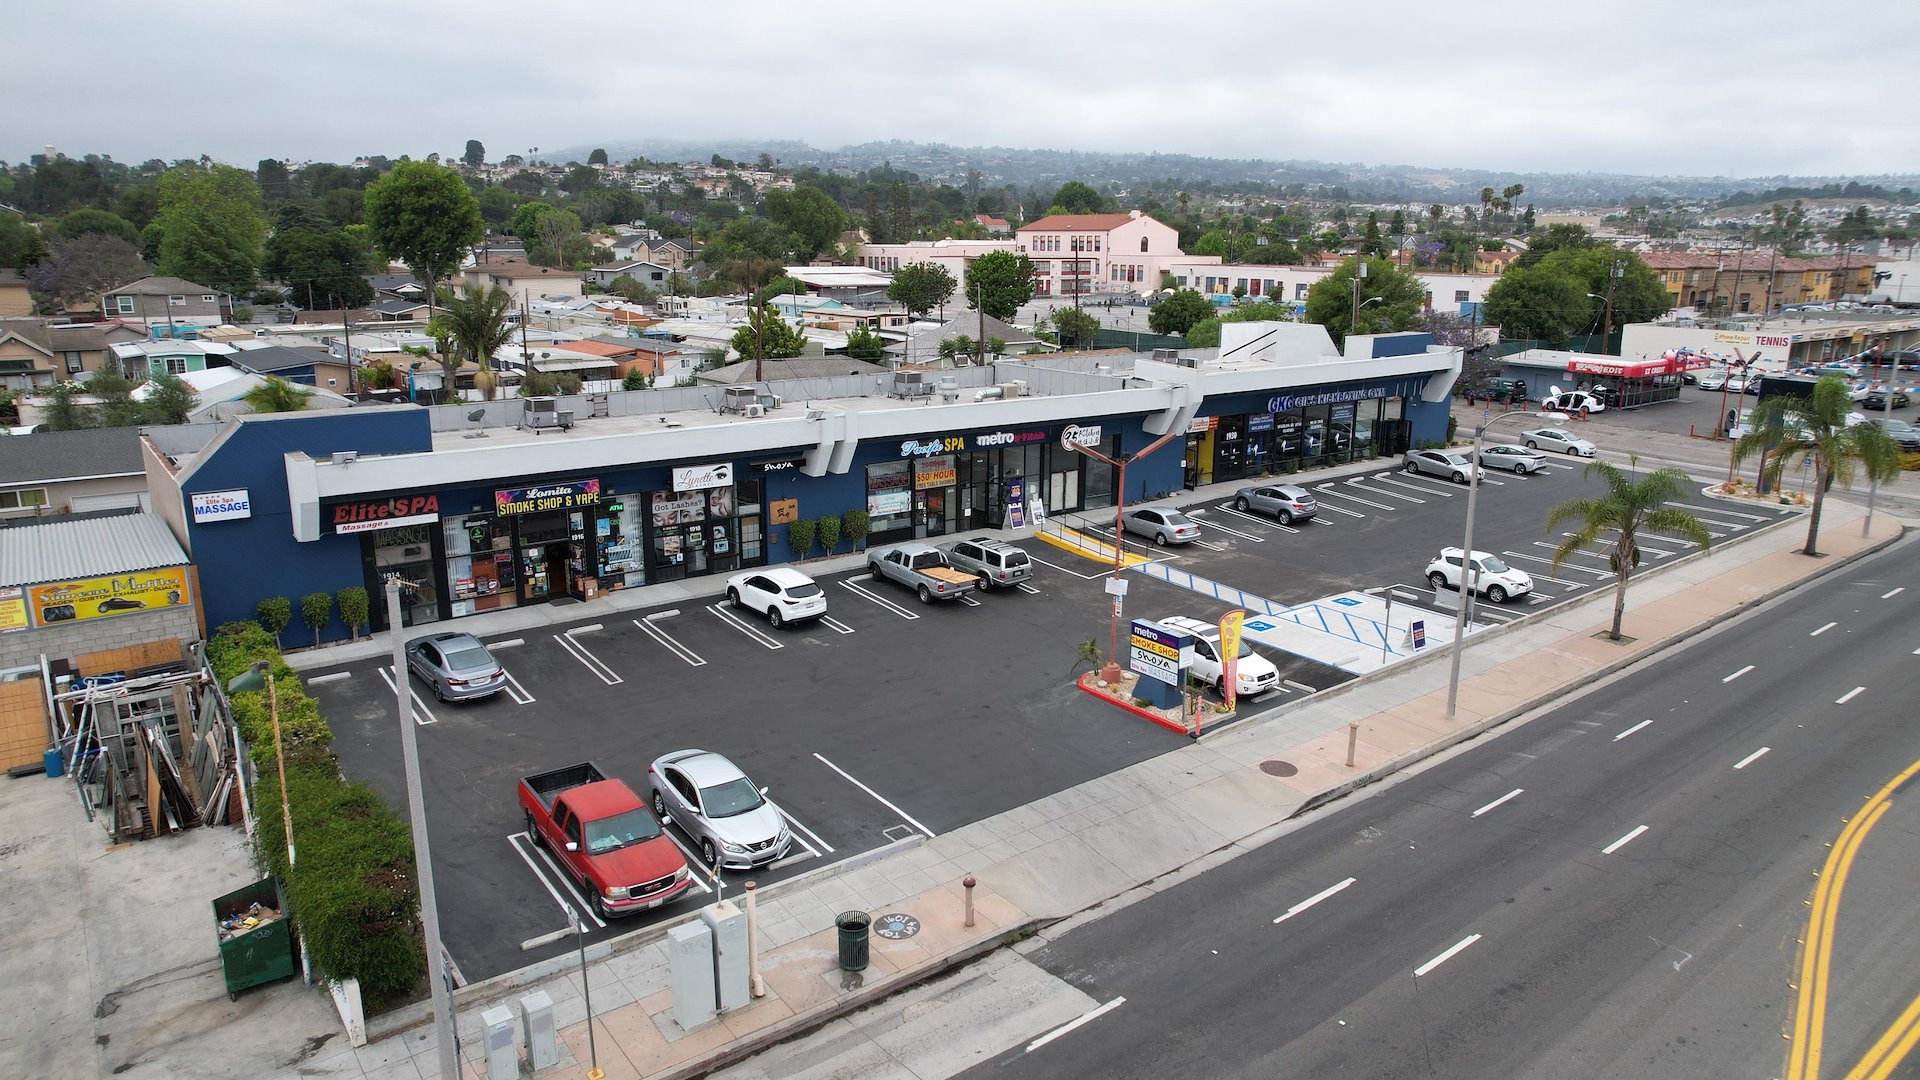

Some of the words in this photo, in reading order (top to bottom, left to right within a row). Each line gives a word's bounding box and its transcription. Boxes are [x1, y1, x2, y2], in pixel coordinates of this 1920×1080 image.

[1755, 336, 1789, 347] TENNIS
[1268, 395, 1293, 413] GKG
[1295, 395, 1317, 407] GIL'S
[1317, 389, 1367, 405] KICKBOXING
[1367, 387, 1386, 398] GYM
[976, 432, 1014, 446] metro
[1226, 431, 1237, 440] 1930
[901, 439, 944, 457] Pacific
[944, 437, 964, 451] SPA
[677, 469, 714, 488] Lynette
[933, 469, 955, 480] HOUR
[525, 486, 573, 499] Lomita
[195, 501, 249, 515] MASSAGE
[333, 503, 389, 523] Elite
[393, 495, 439, 516] SPA
[500, 501, 535, 516] SMOKE
[537, 497, 563, 511] SHOP
[565, 495, 572, 506] &
[575, 492, 599, 505] VAPE
[654, 503, 669, 511] Got
[671, 499, 703, 510] Lashes?
[342, 521, 383, 532] Massage
[375, 527, 427, 548] MASSAGE
[571, 533, 585, 541] 1916
[382, 571, 400, 579] 1914
[40, 588, 109, 602] Supreme
[112, 576, 179, 593] Muffler
[79, 594, 111, 602] CUSTOM
[114, 588, 149, 597] EXHAUST
[1134, 626, 1158, 640] metro
[1131, 636, 1156, 651] SMOKE
[1158, 646, 1179, 658] SHOP
[1148, 665, 1177, 684] MASSAGE
